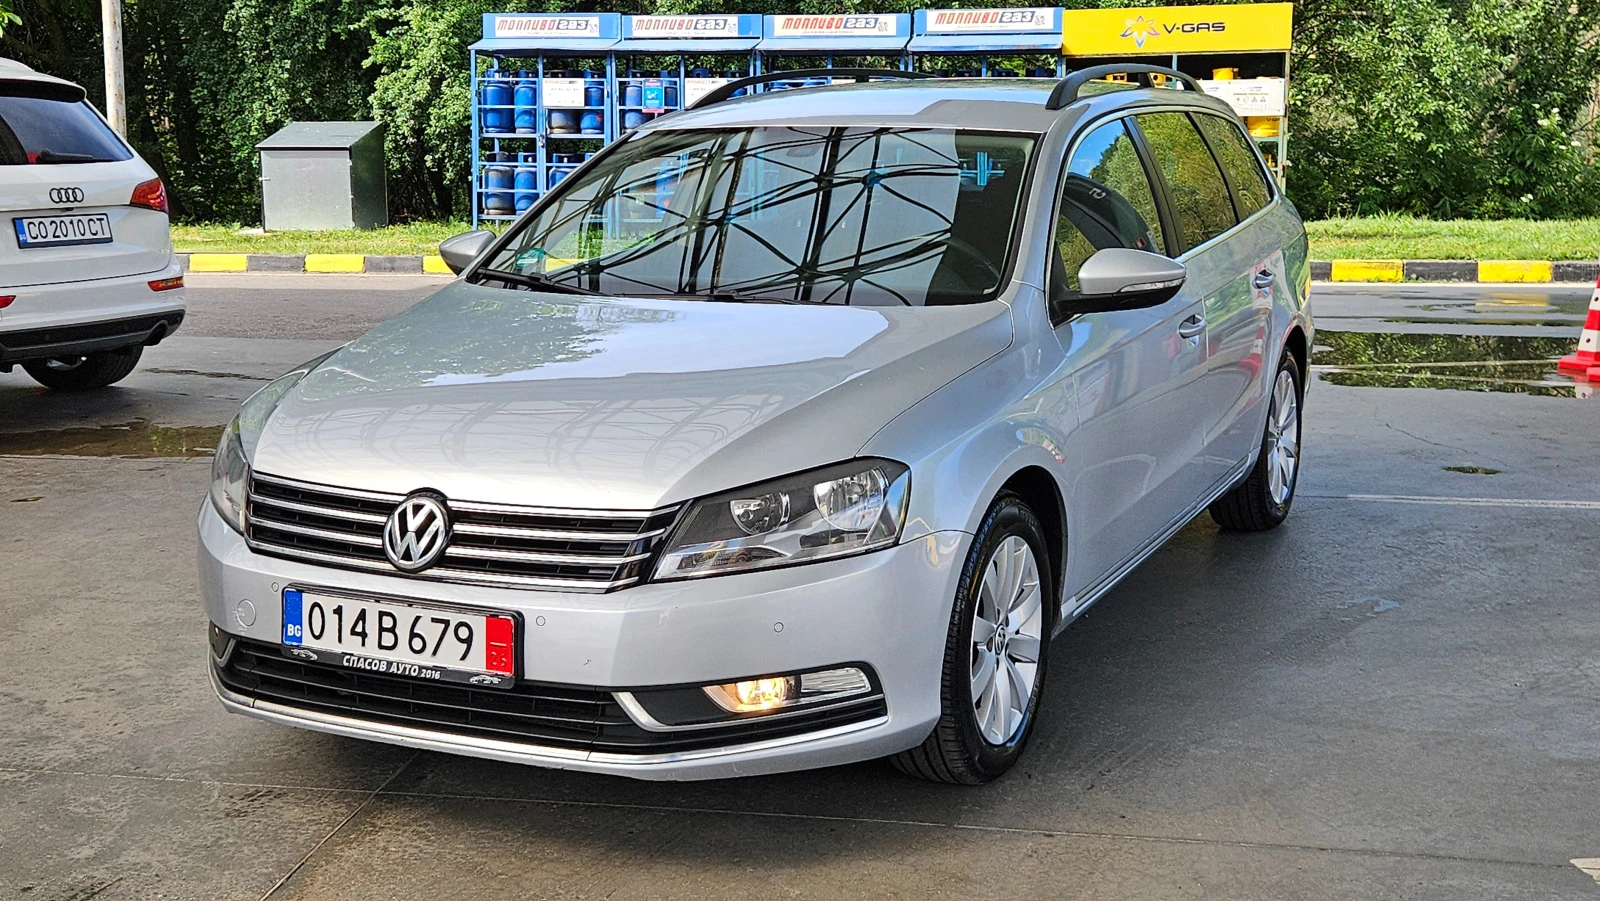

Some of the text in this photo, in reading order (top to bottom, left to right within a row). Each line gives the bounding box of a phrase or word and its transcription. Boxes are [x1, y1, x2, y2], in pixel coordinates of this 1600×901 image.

[1163, 22, 1225, 34] V-GAS
[287, 622, 302, 637] BG
[342, 655, 441, 680] СПАСОВ АУТО 2016
